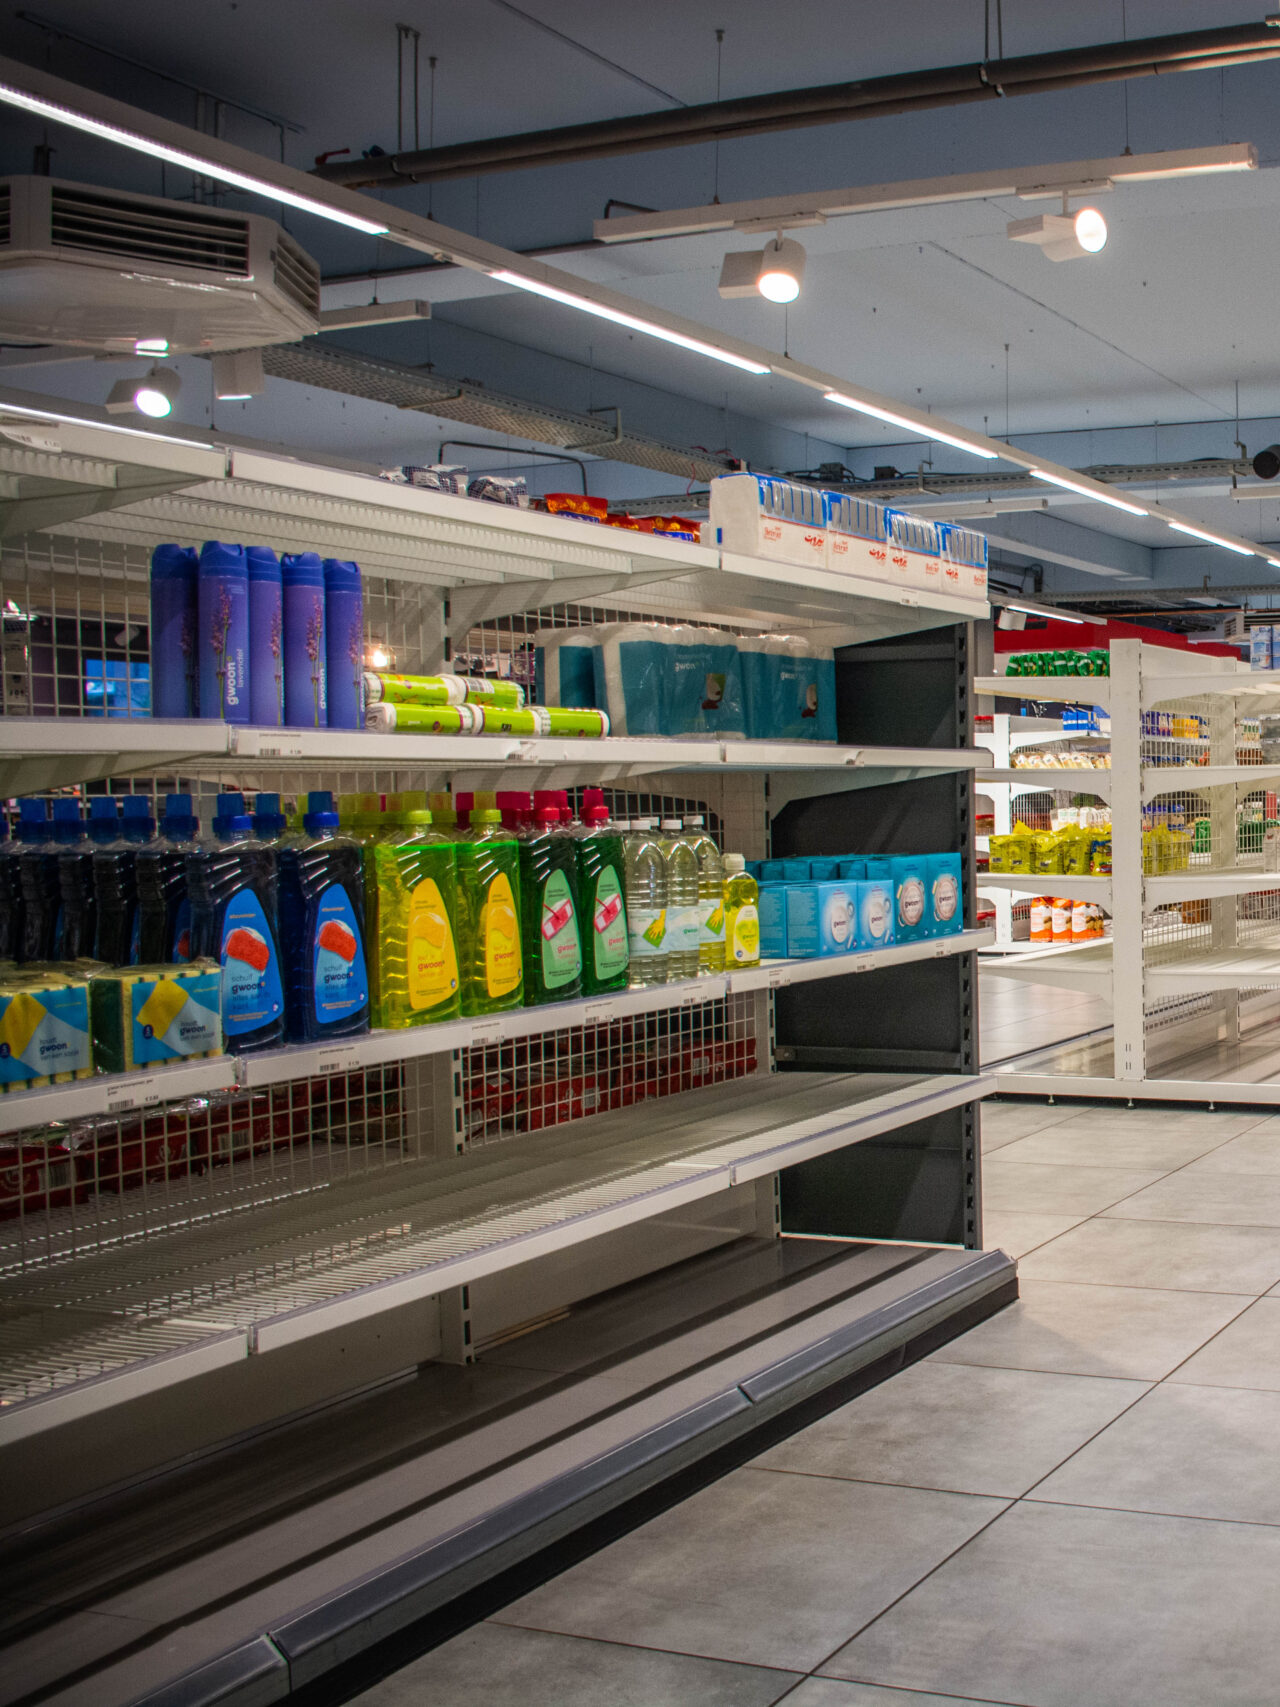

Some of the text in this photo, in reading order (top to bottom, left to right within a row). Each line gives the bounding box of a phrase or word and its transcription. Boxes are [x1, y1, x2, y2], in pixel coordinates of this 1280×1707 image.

[227, 662, 239, 705] gwoon
[417, 960, 443, 972] gwoon
[324, 972, 351, 984] gwoon
[231, 982, 262, 994] gwoon
[180, 1025, 206, 1036] gwoon
[40, 1042, 68, 1055] gwoon
